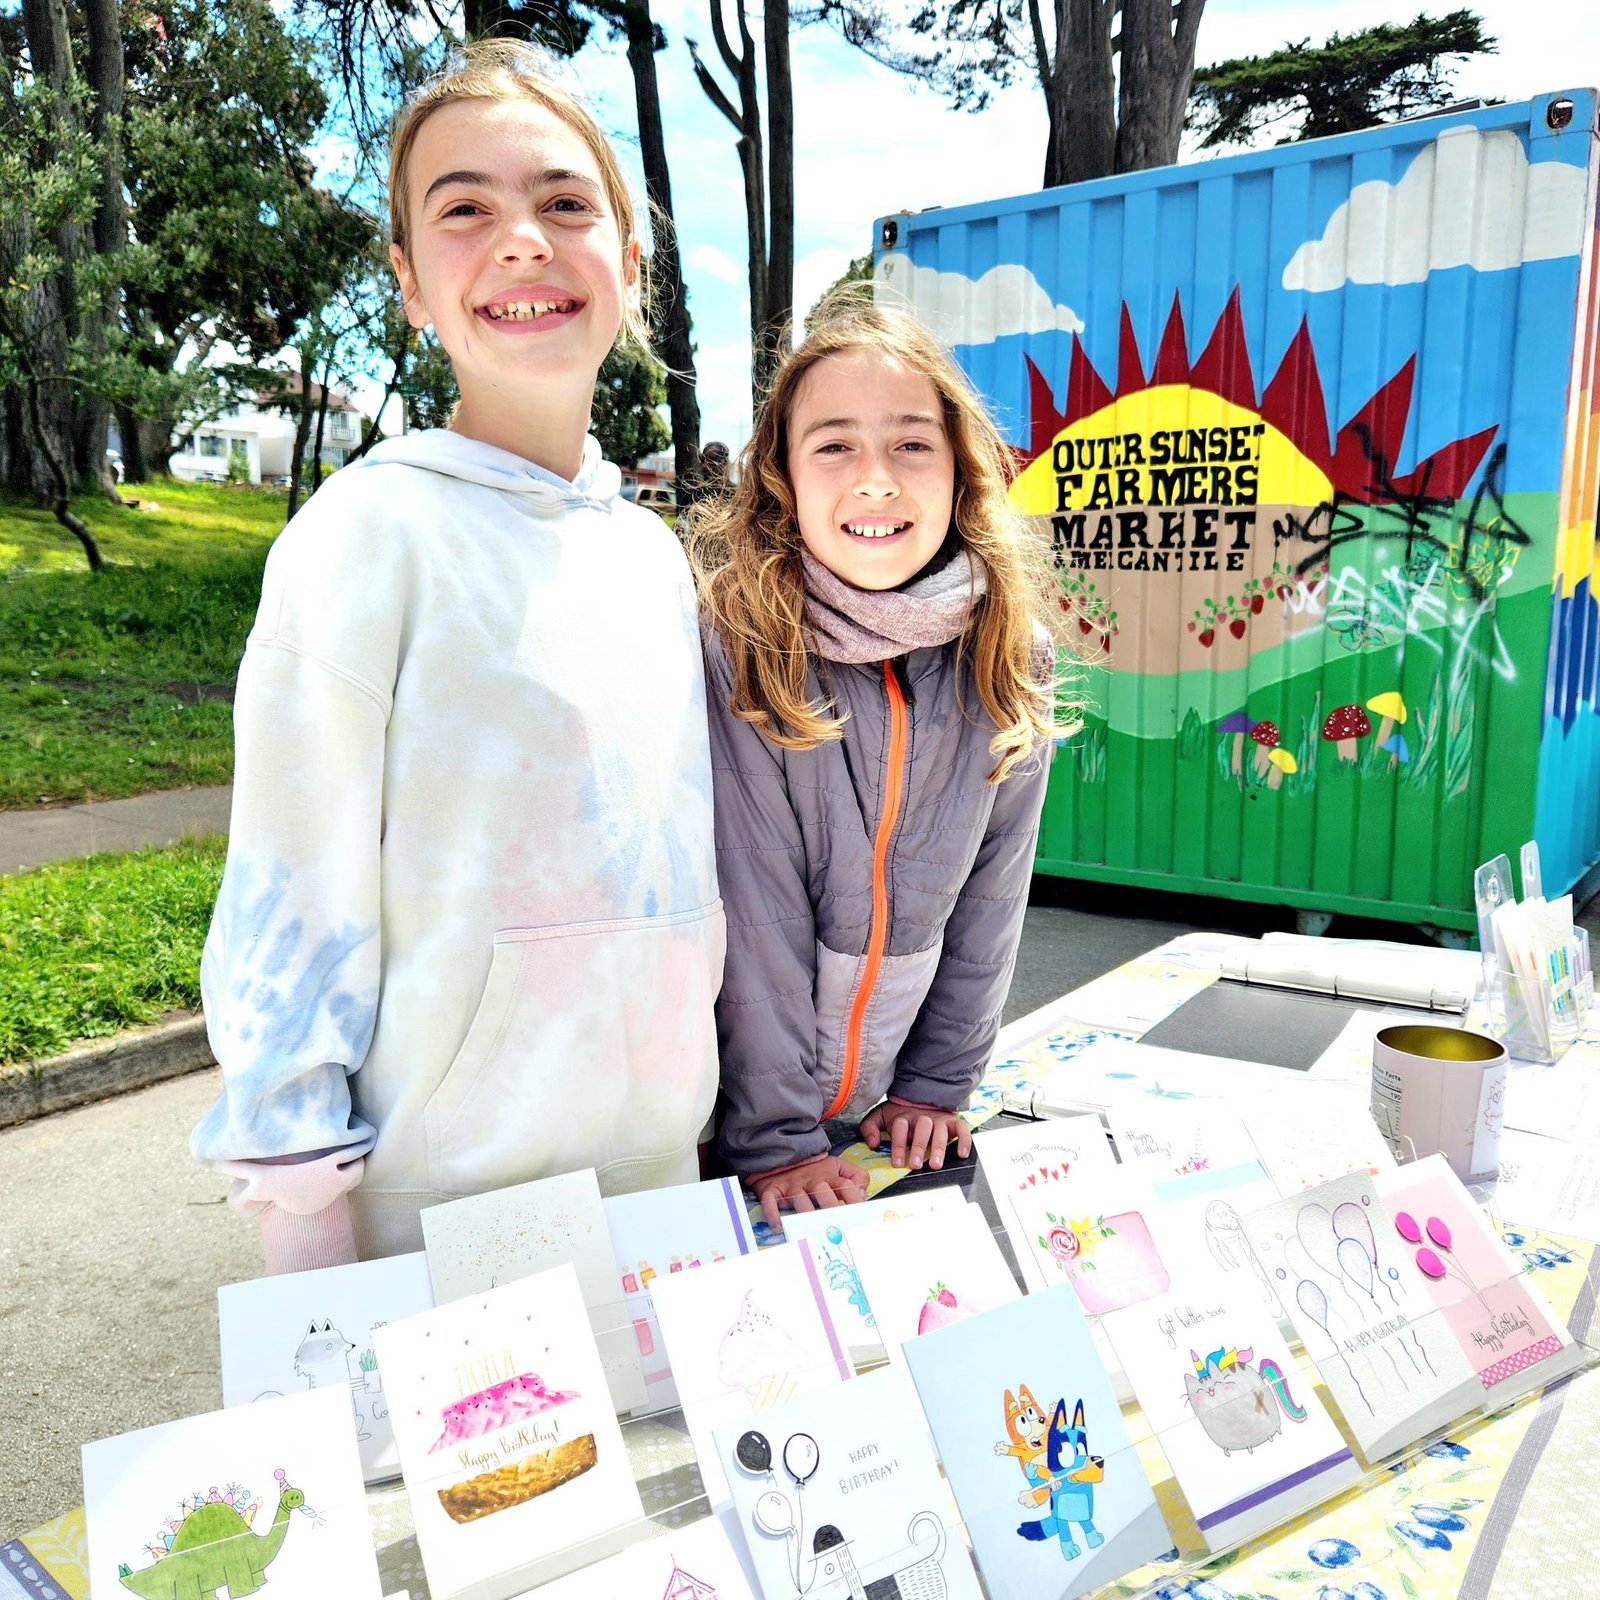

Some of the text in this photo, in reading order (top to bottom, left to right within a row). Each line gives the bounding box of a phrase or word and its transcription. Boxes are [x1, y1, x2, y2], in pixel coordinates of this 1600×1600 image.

[1056, 465, 1258, 512] FARMERS
[1051, 509, 1256, 550] MARKET
[1070, 551, 1245, 572] MECANILE
[1470, 1331, 1503, 1352] Happy
[458, 1420, 562, 1471] Happy Birthday!
[849, 1442, 878, 1463] HAPPY
[839, 1459, 900, 1495] BIRTHDAY!
